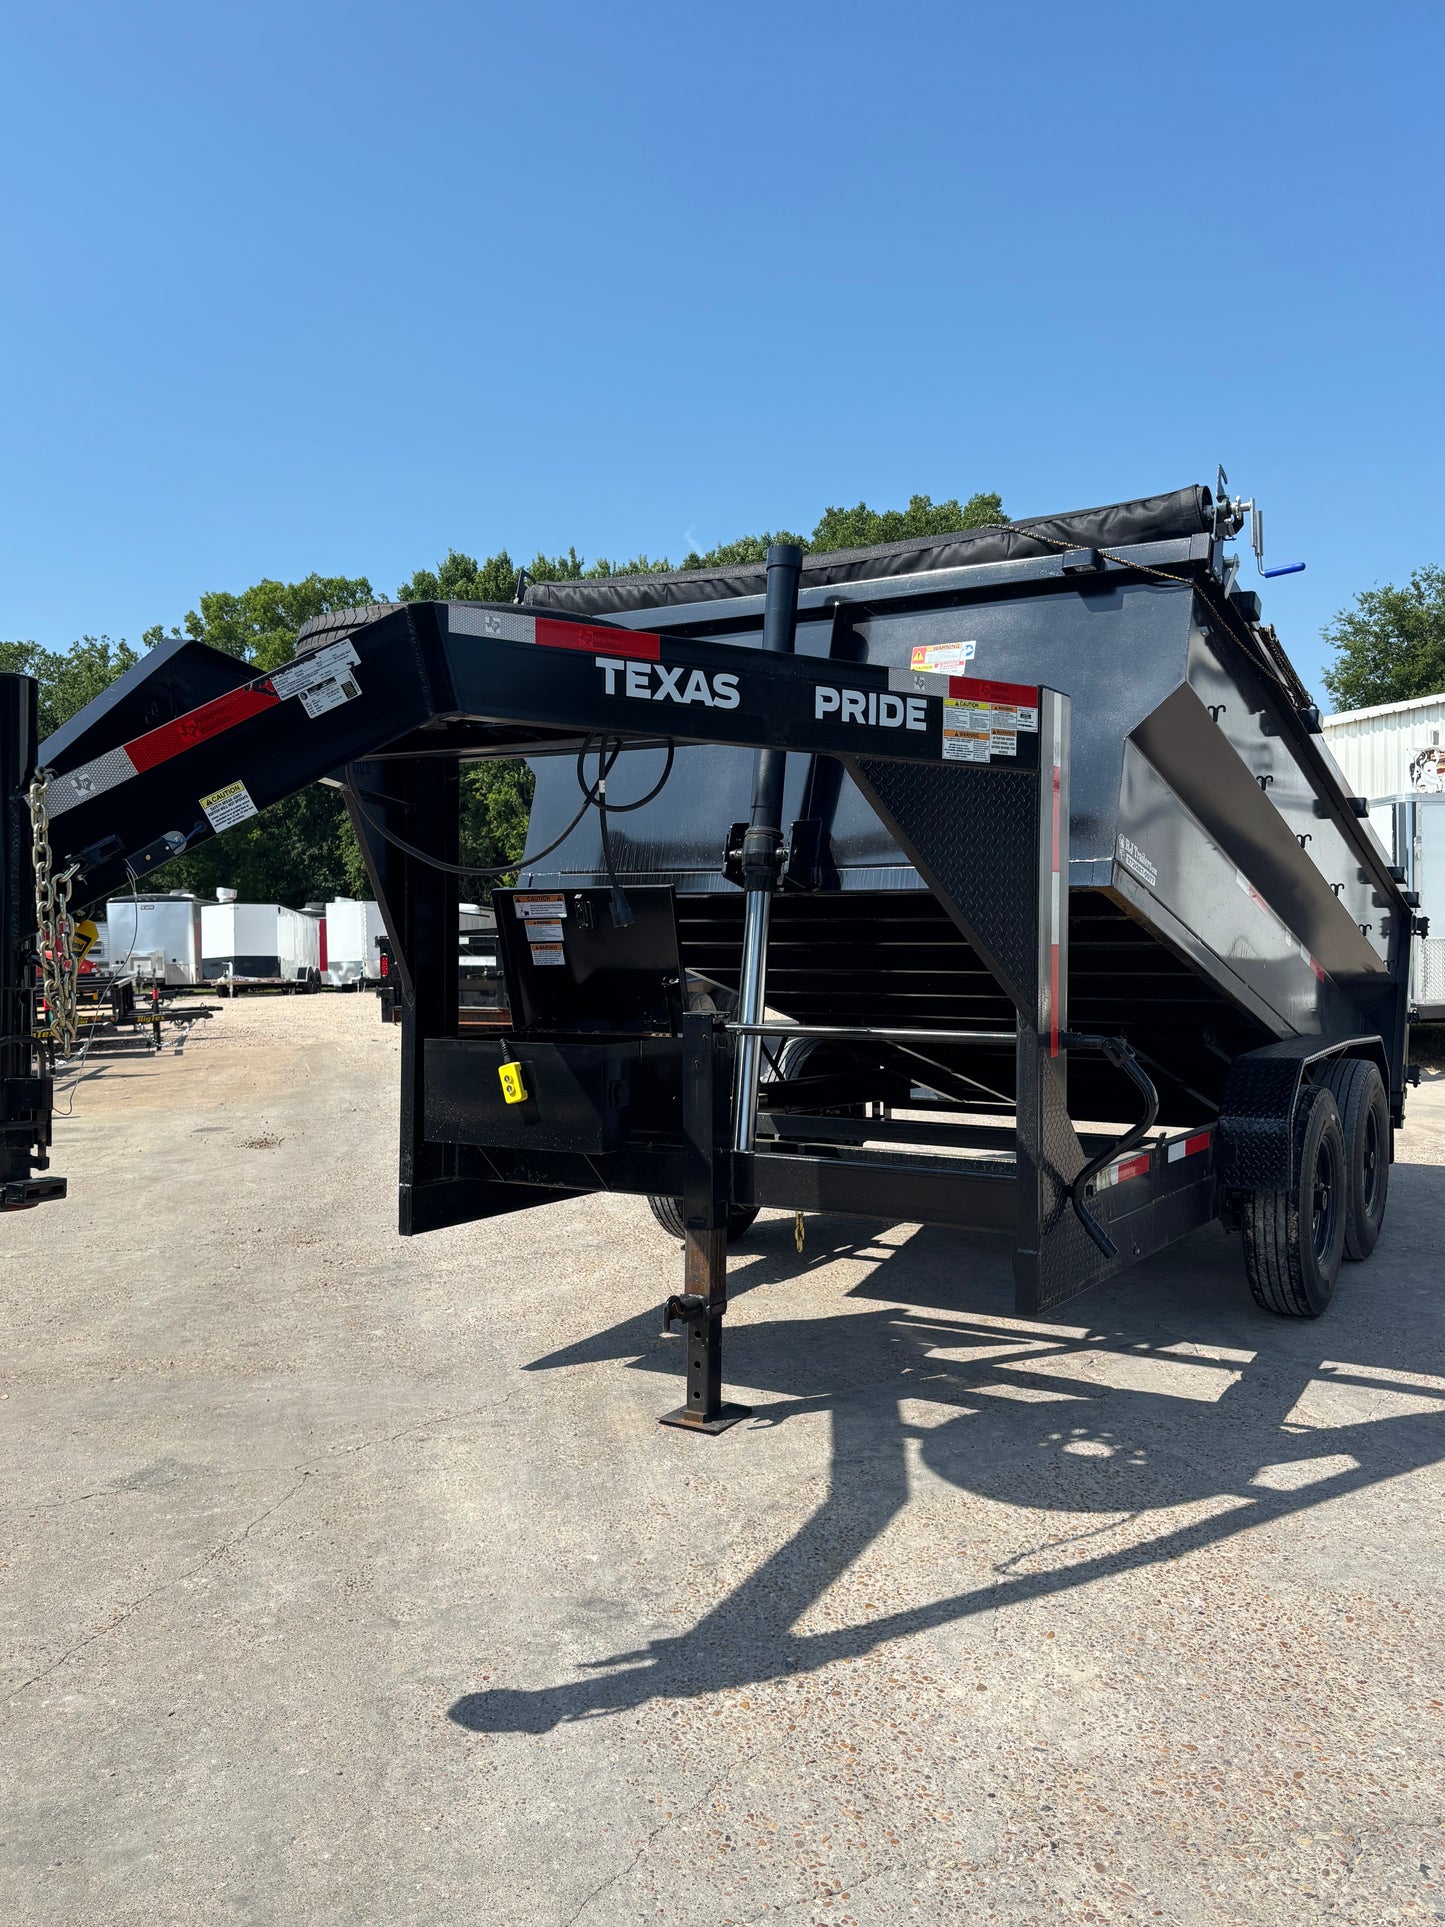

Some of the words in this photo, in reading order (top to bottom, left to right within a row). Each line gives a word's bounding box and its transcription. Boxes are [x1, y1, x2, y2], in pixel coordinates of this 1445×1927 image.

[595, 656, 741, 709] TEXAS
[815, 685, 927, 731] PRIDE
[959, 701, 980, 709] CAUTION
[960, 731, 980, 739] WARNING
[211, 785, 241, 803] CAUTION
